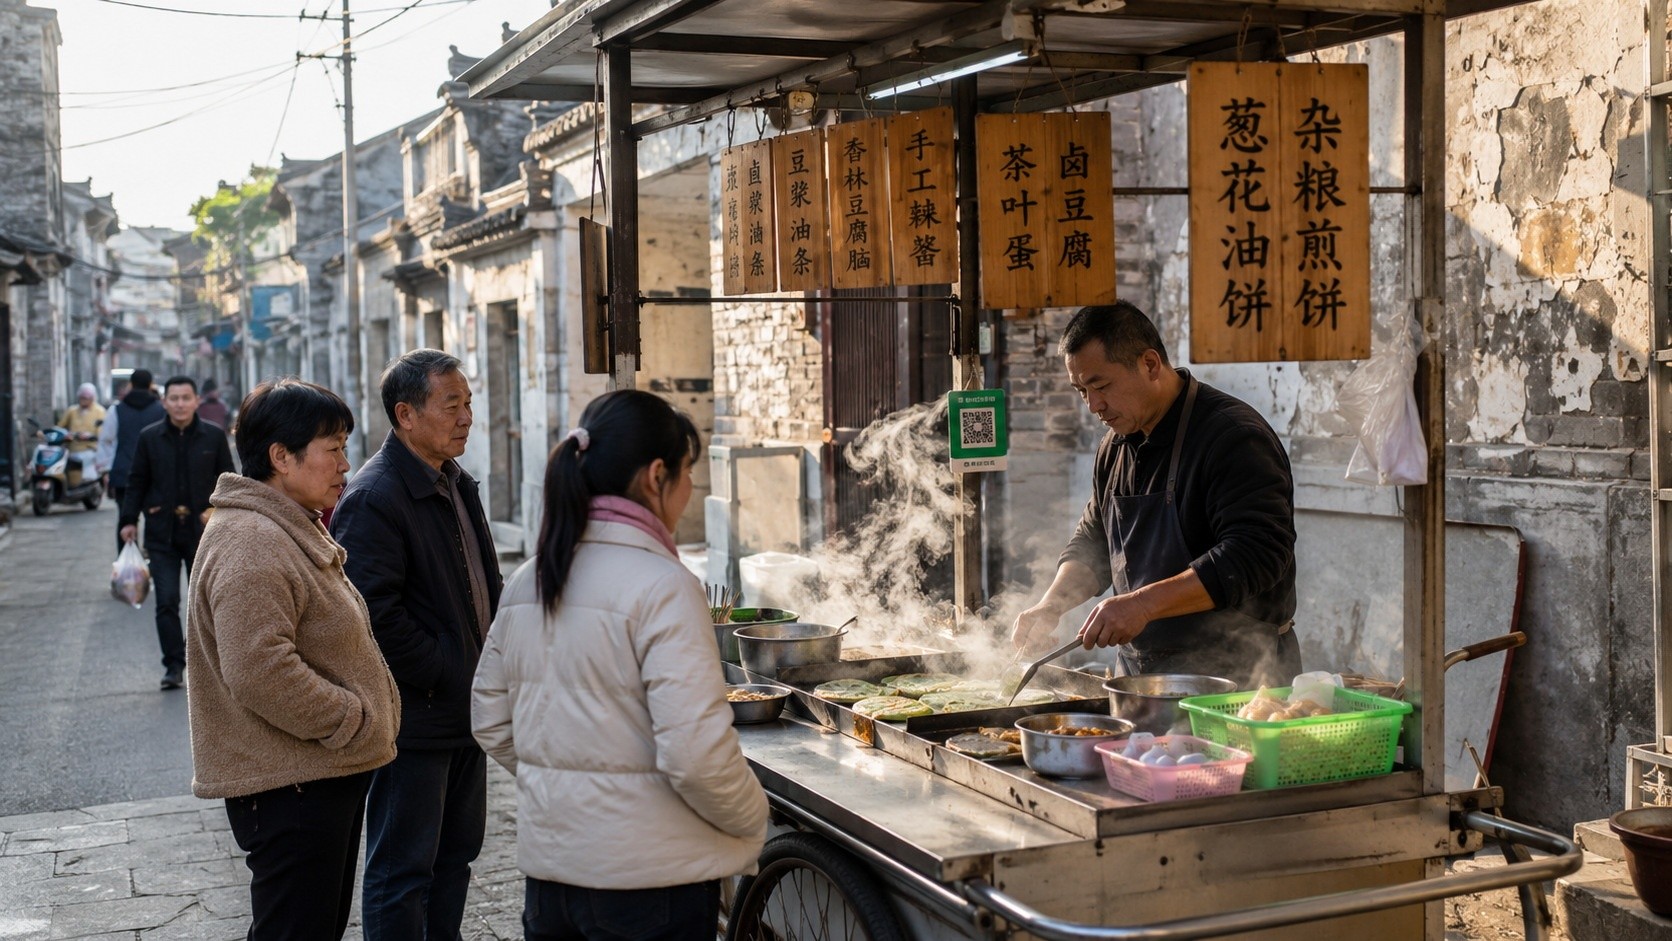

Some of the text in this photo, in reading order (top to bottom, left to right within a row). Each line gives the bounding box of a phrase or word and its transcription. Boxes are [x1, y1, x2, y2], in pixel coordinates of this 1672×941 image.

[788, 149, 813, 276] 豆浆油条
[1000, 143, 1040, 271] 茶叶蛋
[1058, 141, 1094, 269] 卤豆腐
[1218, 98, 1272, 332] 葱花油饼
[1293, 98, 1347, 331] 杂粮煎饼
